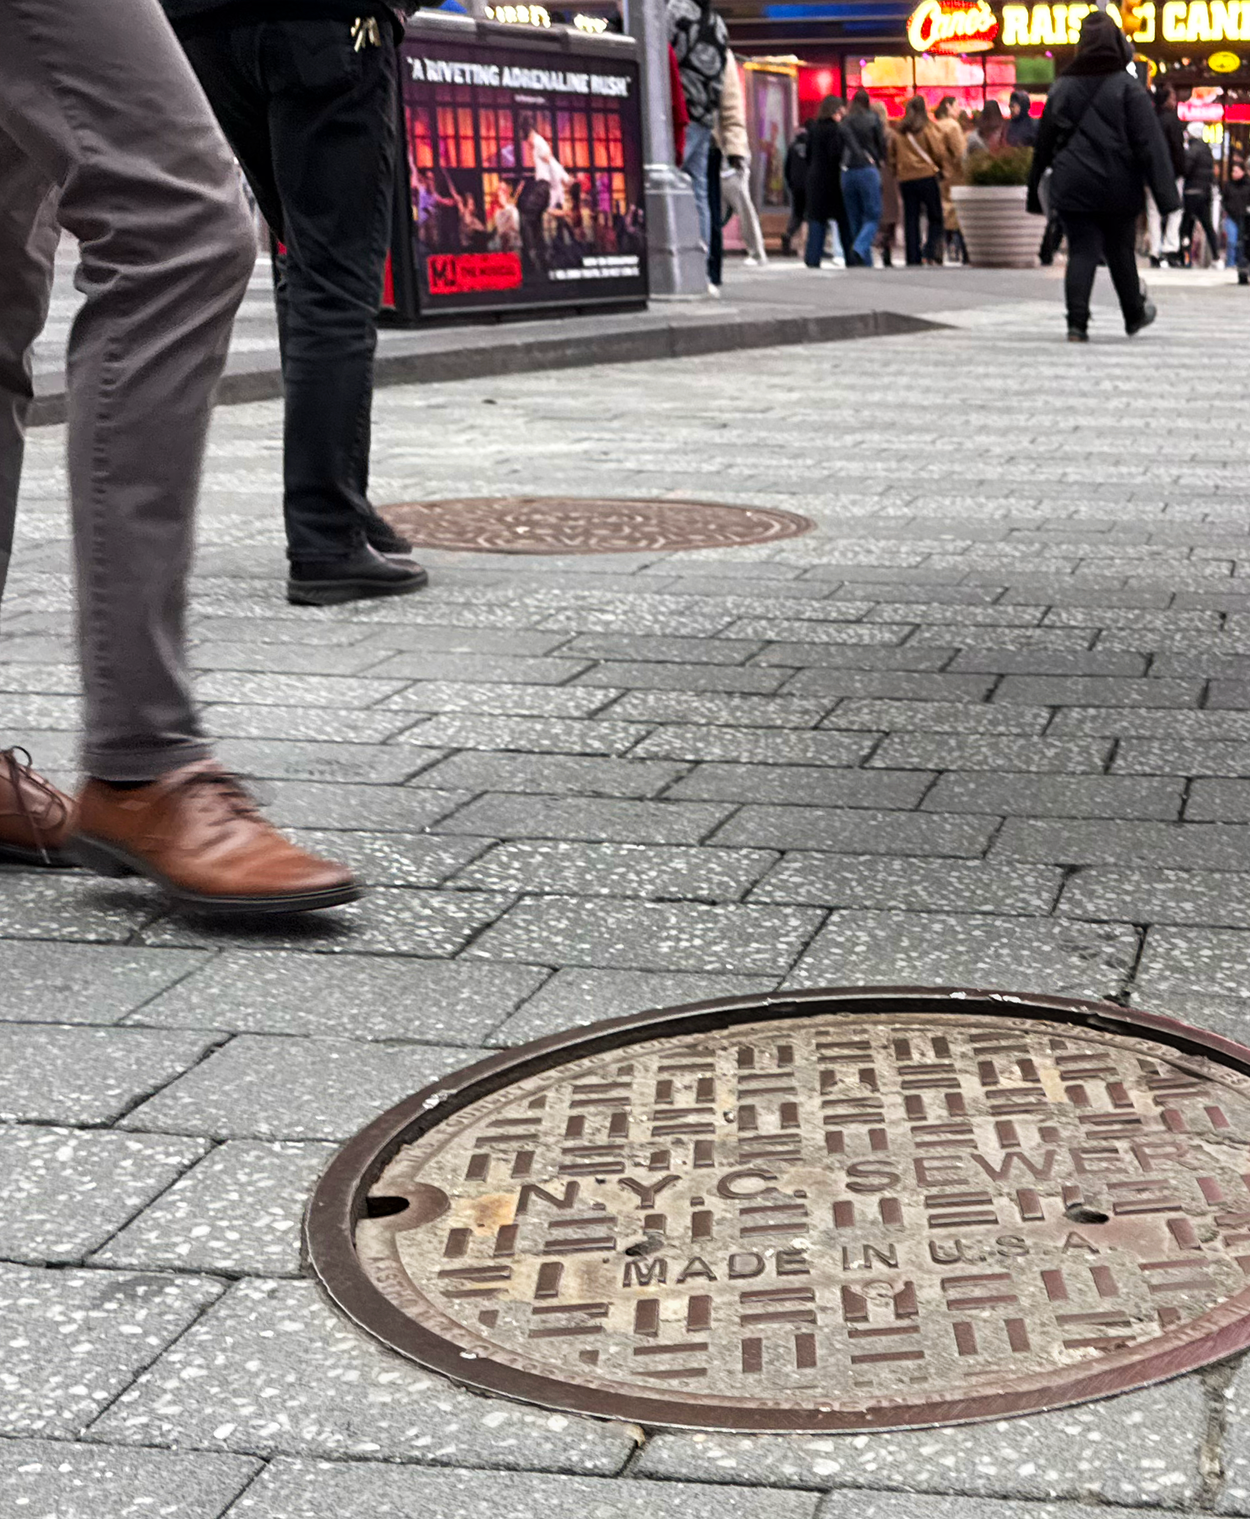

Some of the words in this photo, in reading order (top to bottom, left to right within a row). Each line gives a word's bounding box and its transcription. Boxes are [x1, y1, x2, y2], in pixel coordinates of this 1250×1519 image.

[423, 57, 500, 87] RIVETING
[501, 65, 589, 94] ADRENALINE
[845, 1141, 1192, 1193] SEWER
[622, 1249, 811, 1289] MADE
[841, 1242, 900, 1272] IN
